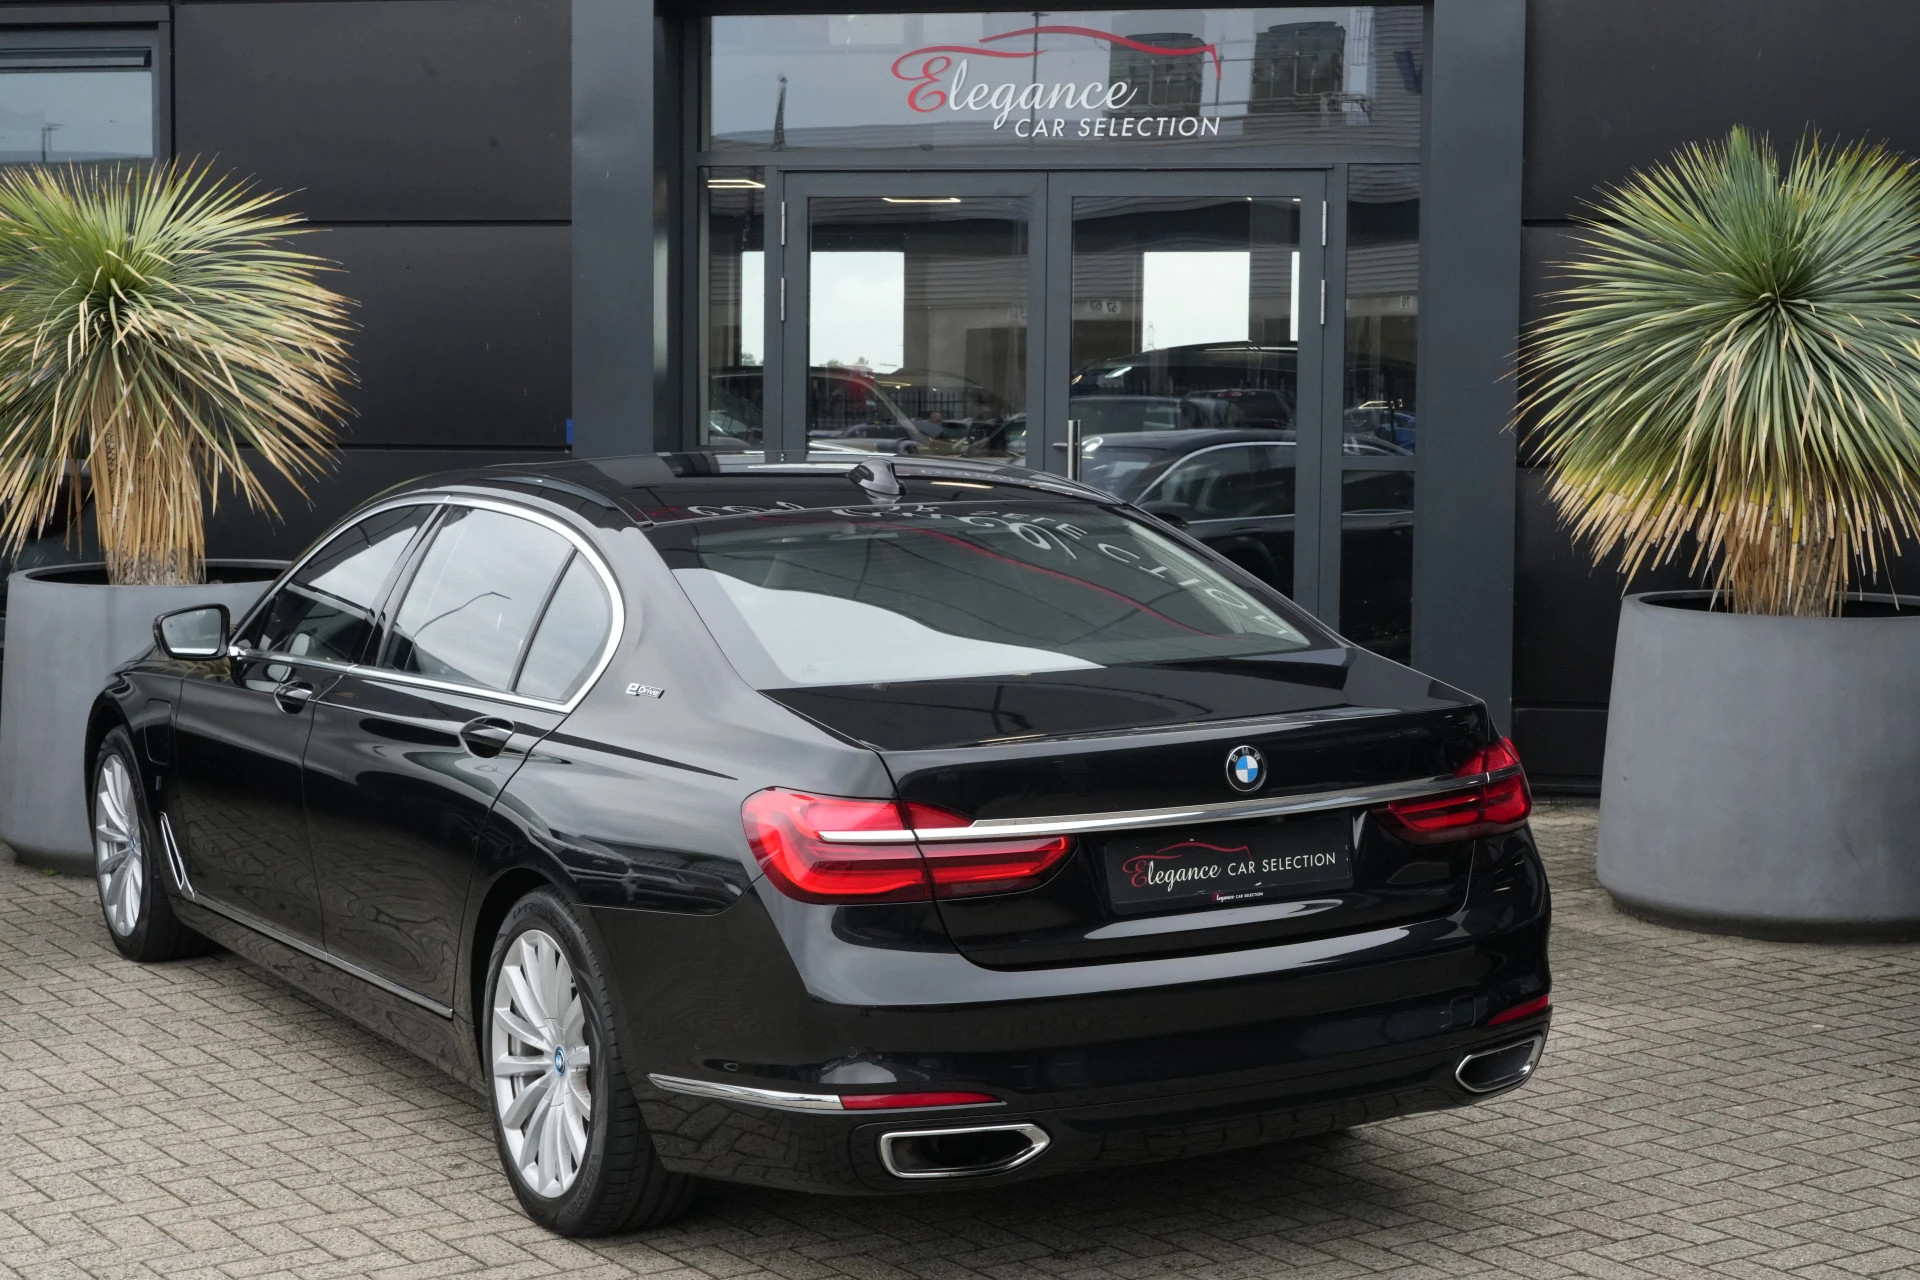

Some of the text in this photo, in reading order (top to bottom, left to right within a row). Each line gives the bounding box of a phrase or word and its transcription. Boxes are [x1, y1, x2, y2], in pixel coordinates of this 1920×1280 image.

[891, 46, 1137, 130] Elegance
[1015, 117, 1220, 137] CAR SELECTION
[1230, 747, 1261, 763] BMW
[1122, 852, 1336, 892] Elegance CAR SELECTION
